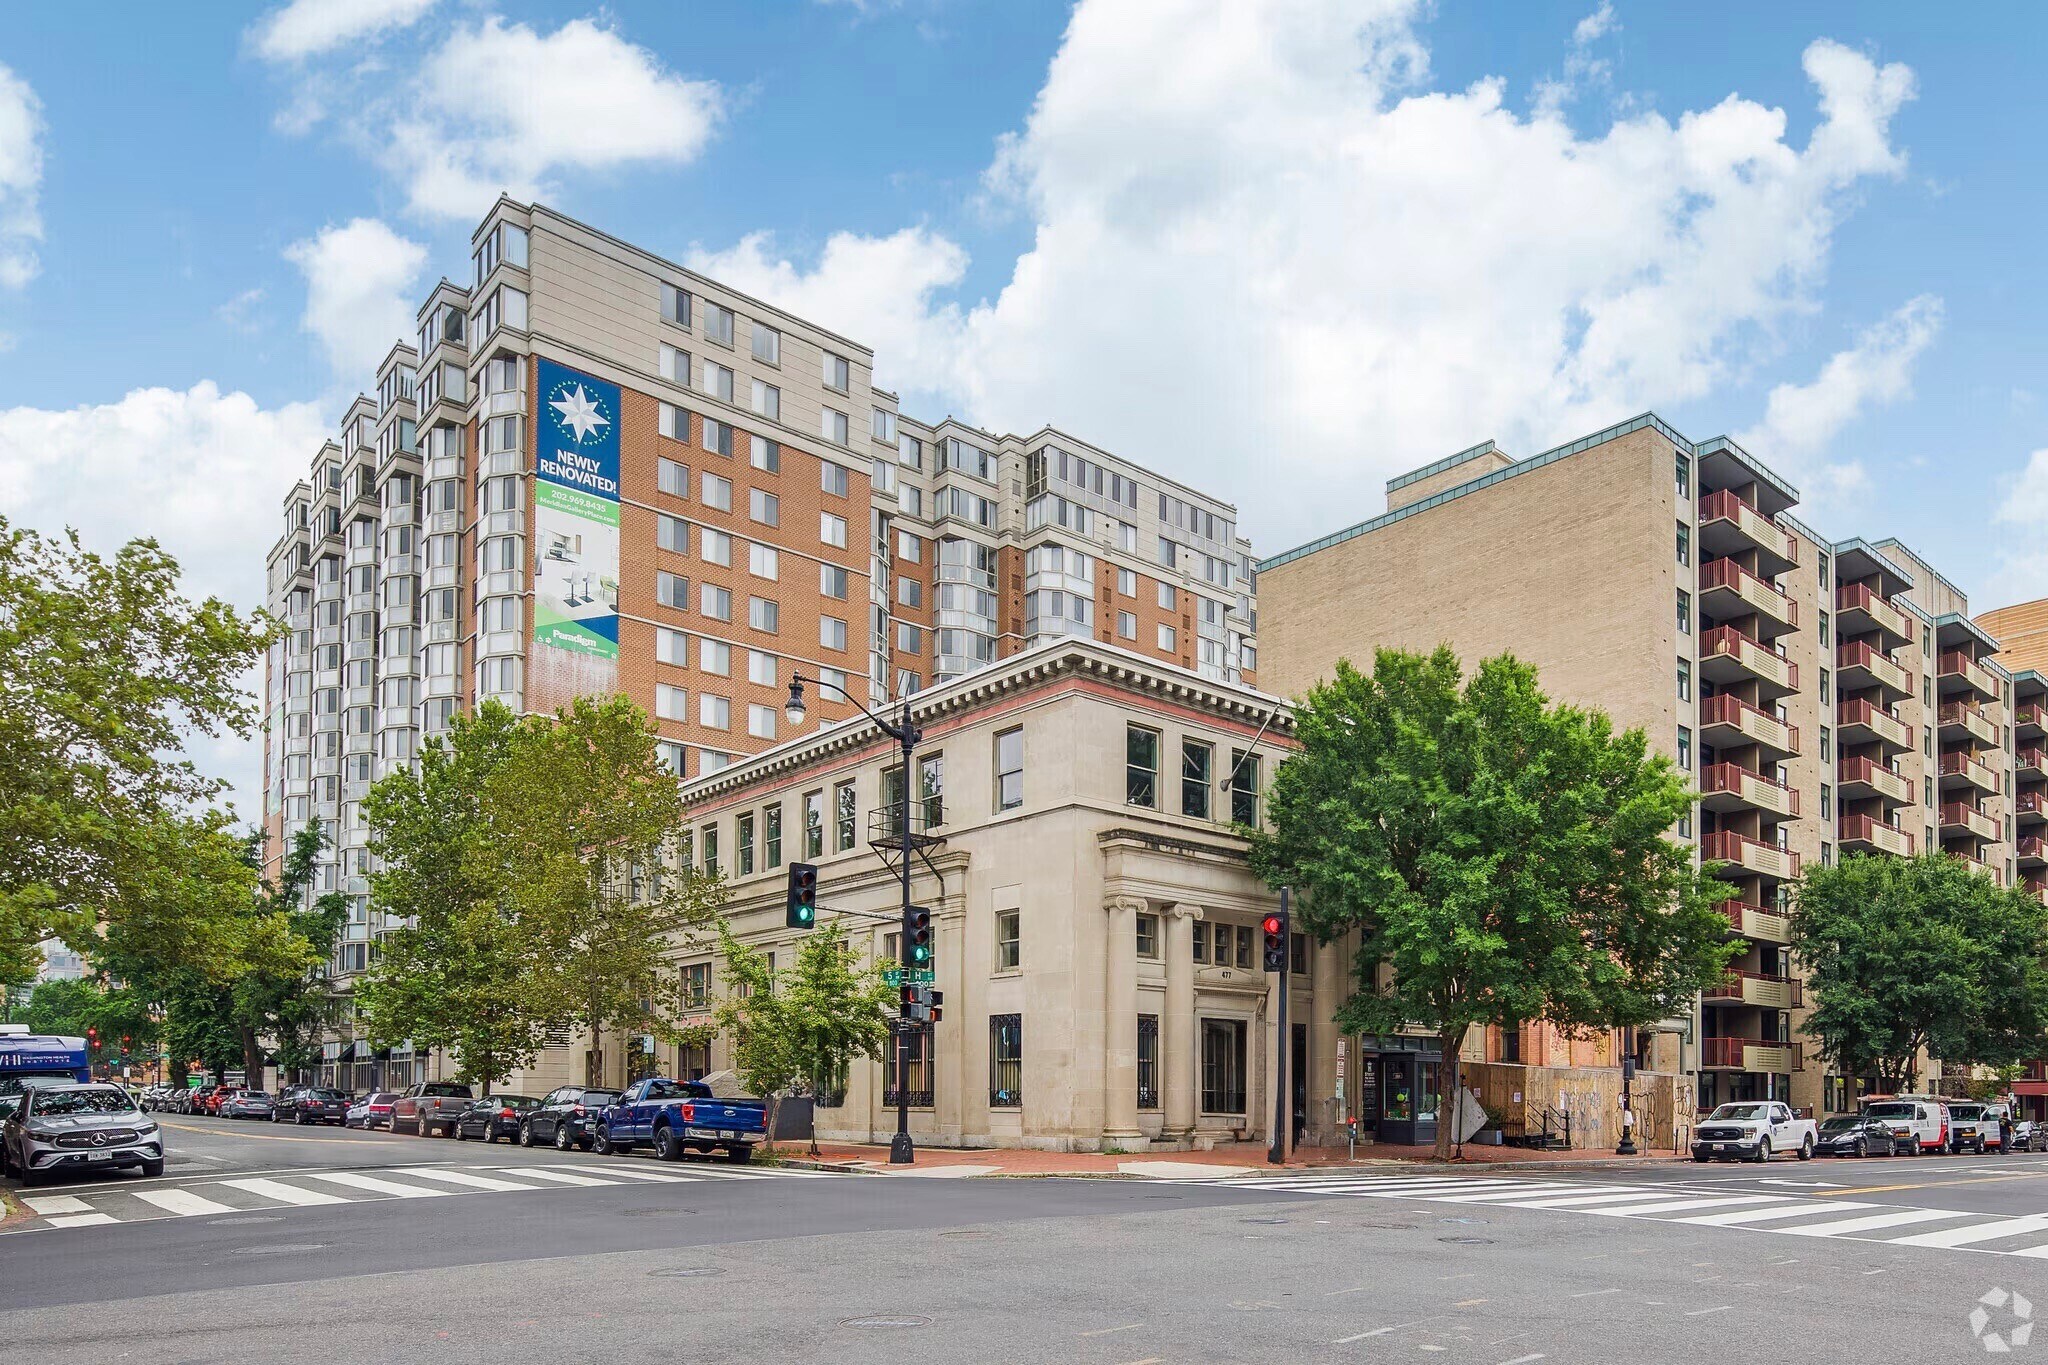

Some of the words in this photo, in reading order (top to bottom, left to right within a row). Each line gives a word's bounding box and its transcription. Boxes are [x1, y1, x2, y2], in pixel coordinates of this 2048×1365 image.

[557, 449, 600, 474] NEWLY
[540, 458, 617, 494] RENOVATED!
[540, 497, 616, 523] MeridianGalleryPlace.com
[551, 489, 606, 513] 202.969.8435
[552, 629, 597, 647] Paradigm
[914, 971, 921, 980] H
[1222, 971, 1231, 979] 477
